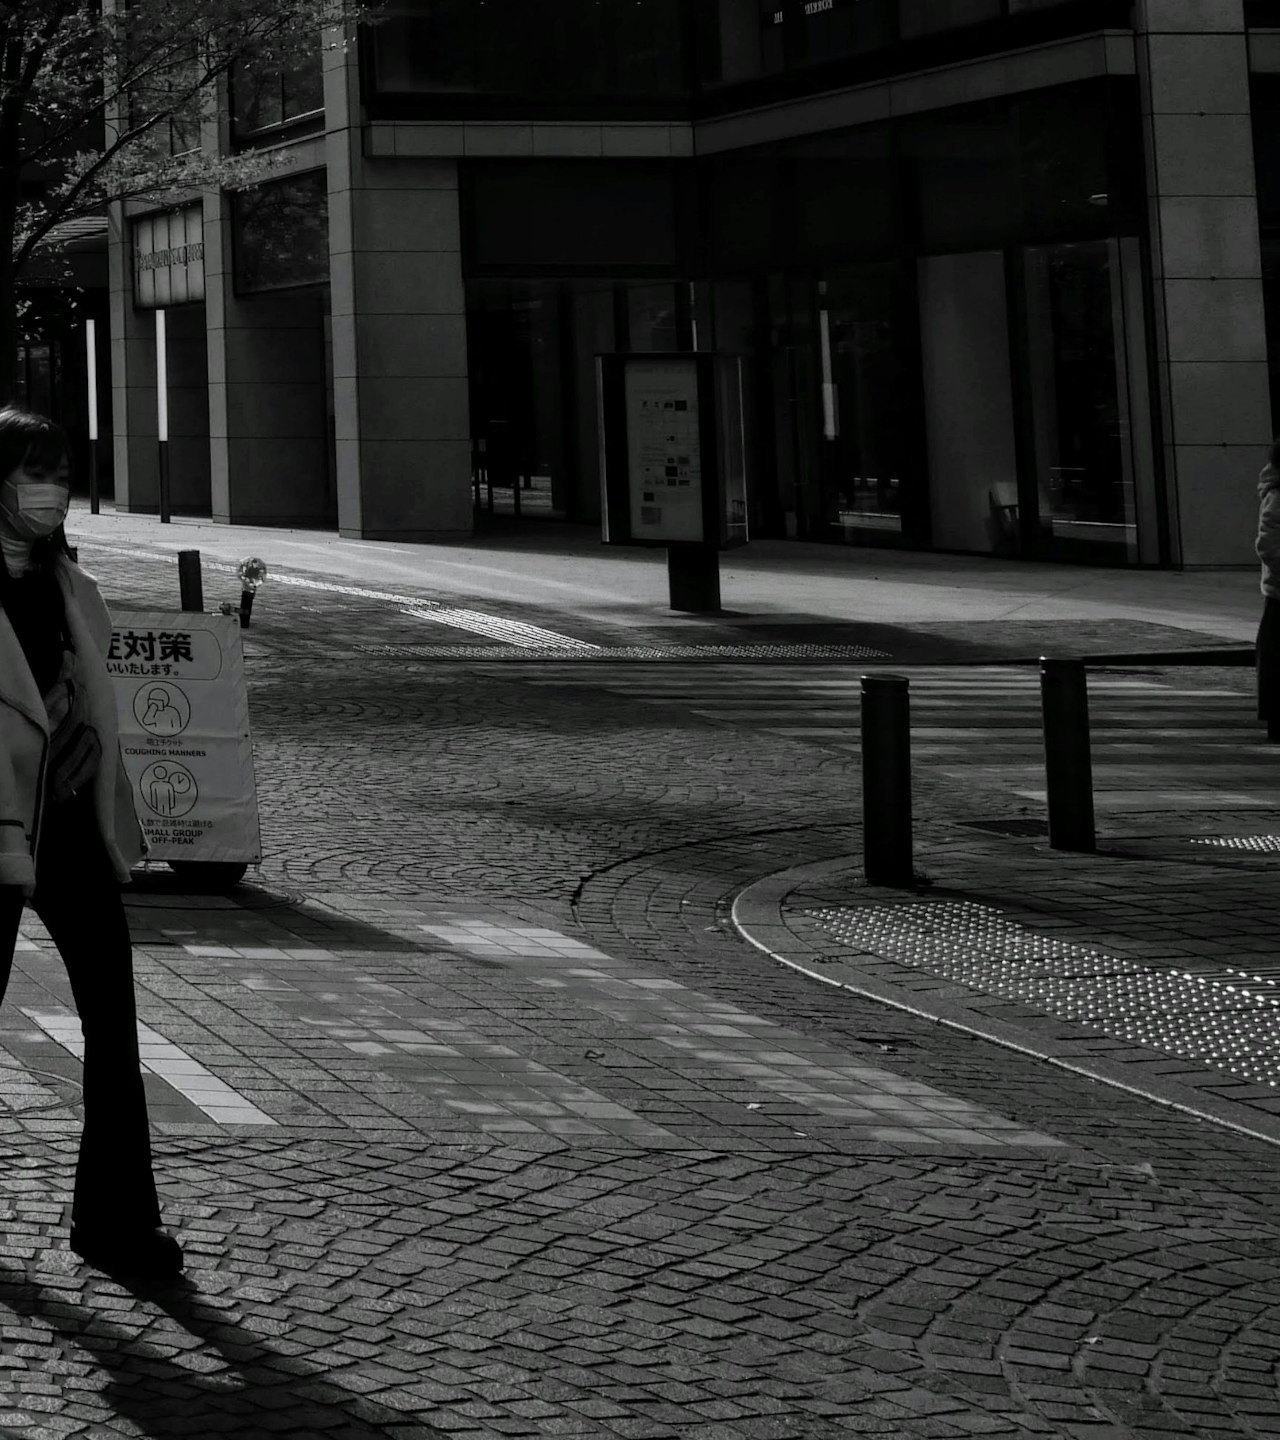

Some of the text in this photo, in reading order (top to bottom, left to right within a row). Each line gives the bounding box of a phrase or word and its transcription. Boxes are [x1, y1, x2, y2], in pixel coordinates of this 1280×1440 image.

[124, 748, 167, 756] COUGHING
[172, 829, 203, 837] GROUP
[151, 837, 195, 845] OFF-PEAK
